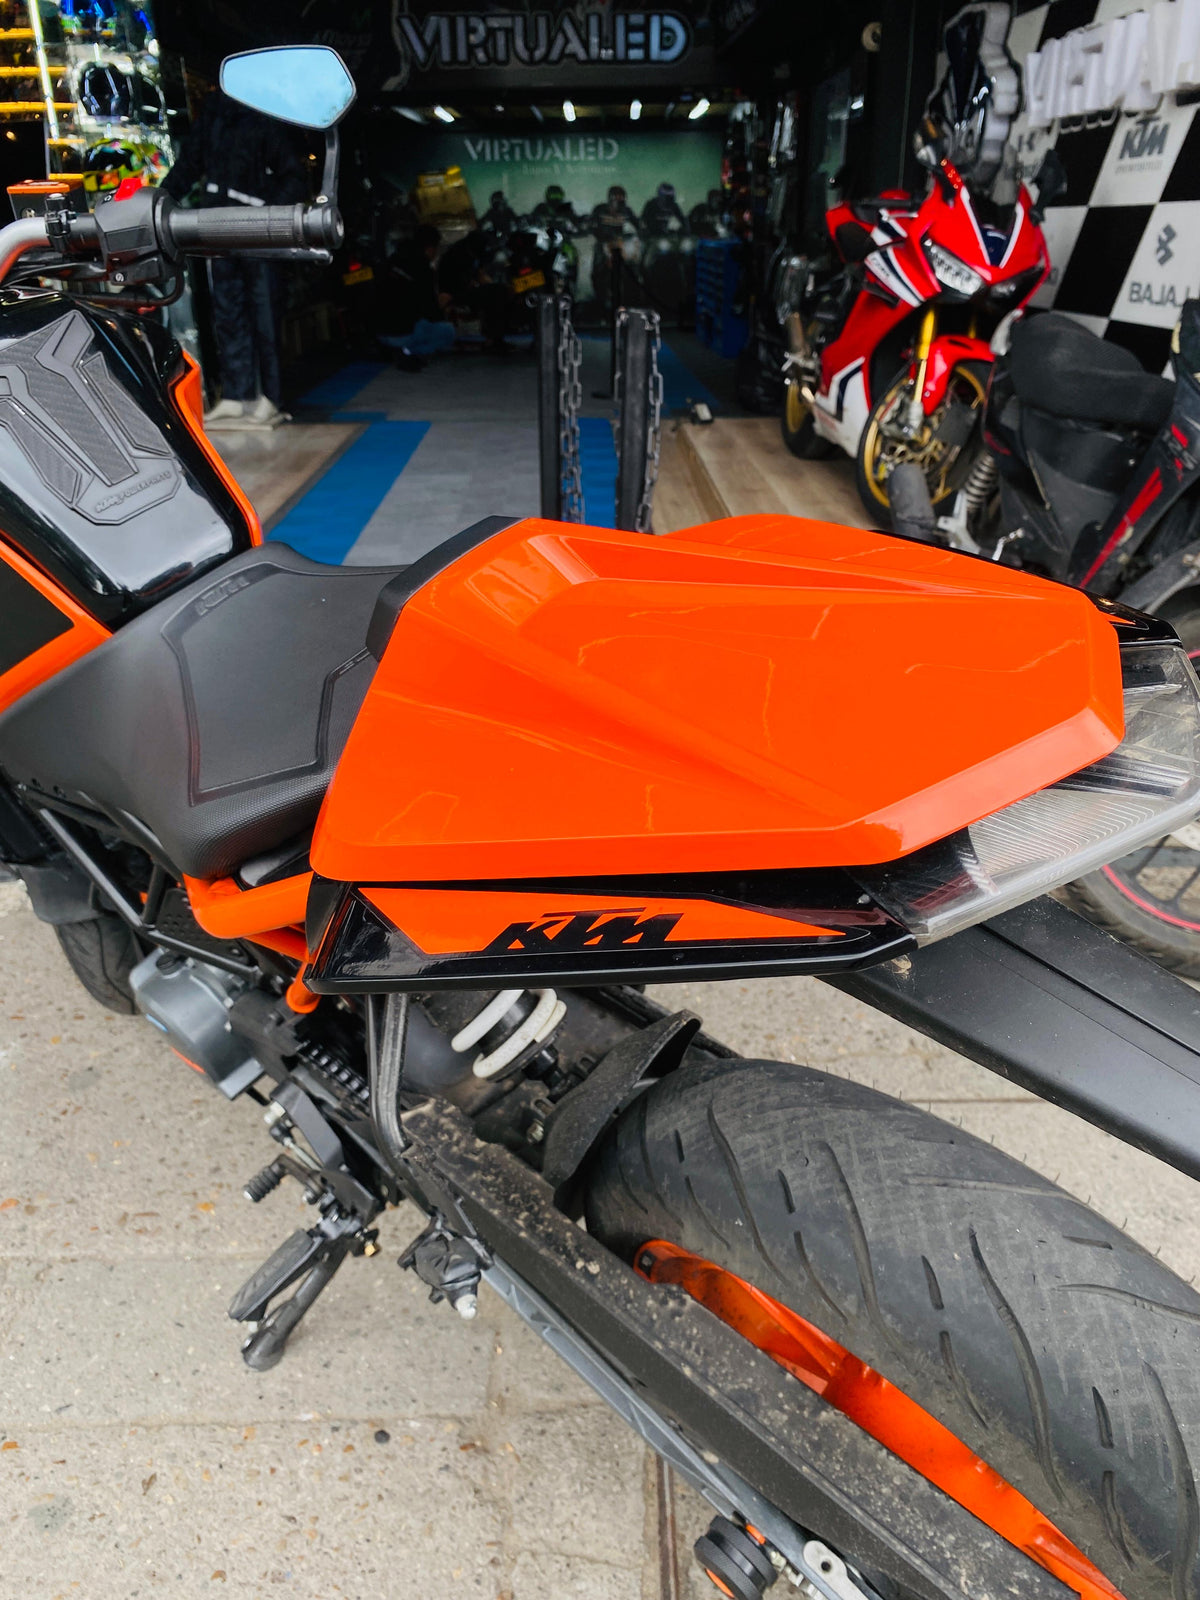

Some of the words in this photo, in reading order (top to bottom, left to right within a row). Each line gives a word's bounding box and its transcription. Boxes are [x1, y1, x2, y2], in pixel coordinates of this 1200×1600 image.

[397, 11, 688, 63] VIRTUALED
[463, 136, 620, 162] VIRTUALED
[1119, 117, 1171, 160] KTM
[482, 906, 685, 955] KTM
